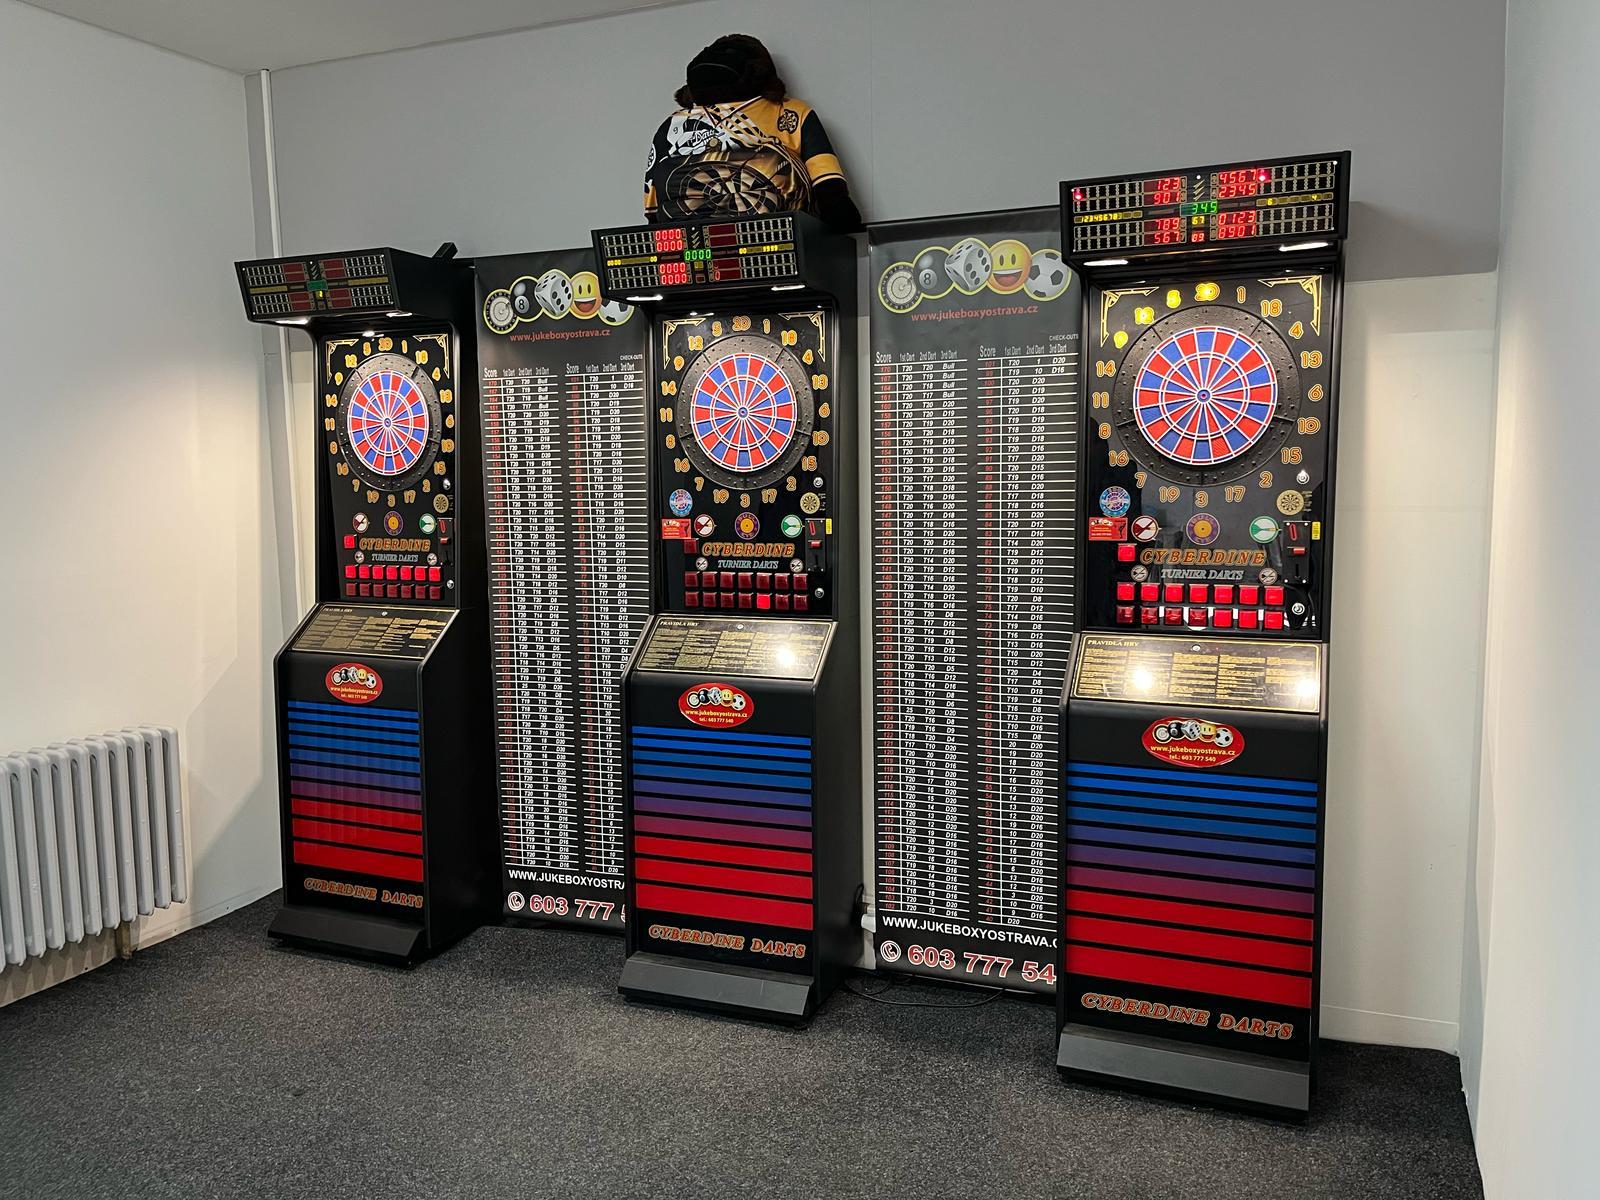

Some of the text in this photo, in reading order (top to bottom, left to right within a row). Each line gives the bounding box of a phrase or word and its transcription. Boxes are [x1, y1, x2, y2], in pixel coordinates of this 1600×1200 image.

[1157, 177, 1180, 191] 123
[1219, 169, 1257, 184] 4567
[1153, 191, 1180, 204] 901
[1219, 183, 1256, 198] 2345
[1192, 202, 1217, 213] 345
[1155, 217, 1180, 230] 789
[1191, 216, 1205, 225] 67
[1218, 211, 1256, 224] 0123
[655, 229, 681, 240] 0000
[1154, 231, 1180, 244] 567
[1191, 232, 1205, 242] 89
[1218, 225, 1256, 238] 8901
[656, 240, 683, 252] 0000
[684, 249, 712, 262] 0000
[659, 262, 686, 274] 0000
[661, 273, 688, 285] 0000
[923, 272, 932, 285] 8
[1236, 286, 1246, 303] 1
[911, 304, 1039, 321] www.jukeboxyostrava.cz
[1261, 299, 1282, 317] 18
[732, 315, 751, 331] 20
[763, 318, 771, 334] 1
[1289, 321, 1304, 339] 4
[509, 329, 611, 343] www.jukeboxyostrava.cz
[802, 349, 814, 364] 4
[876, 352, 892, 363] Score
[980, 346, 996, 357] Score
[1300, 350, 1322, 368] 13
[484, 368, 497, 378] Score
[566, 363, 579, 373] Score
[1096, 360, 1116, 378] 14
[661, 380, 677, 396] 14
[812, 374, 829, 390] 13
[1092, 392, 1109, 408] 11
[1308, 384, 1323, 401] 6
[659, 407, 673, 423] 11
[1098, 423, 1111, 439] 8
[1298, 417, 1320, 434] 10
[801, 456, 818, 471] 15
[1108, 450, 1129, 466] 16
[1281, 447, 1302, 465] 15
[673, 457, 691, 473] 16
[786, 476, 797, 492] 2
[1135, 472, 1147, 488] 7
[1259, 471, 1273, 488] 2
[761, 488, 778, 503] 17
[1159, 486, 1180, 503] 19
[1195, 490, 1208, 507] 3
[1225, 486, 1246, 503] 17
[359, 537, 431, 552] CYBERDINE
[702, 542, 795, 558] CYBERDINE
[717, 560, 779, 569] TURNIER DARTS
[1140, 548, 1267, 567] CYBERDINE
[1160, 569, 1244, 580] TURNIER DARTS
[1087, 639, 1123, 647] PRAVIDLA
[1150, 745, 1236, 756] www.jukeboxyostrava.cz
[1181, 754, 1193, 762] 603
[304, 877, 424, 908] CYBERDINE DARTS
[530, 894, 569, 915] 603
[574, 898, 614, 921] 777
[648, 924, 806, 958] CYBERDINE DARTS
[907, 944, 1057, 985] 603 777 54
[1080, 992, 1294, 1040] CYBERDINE DARTS
